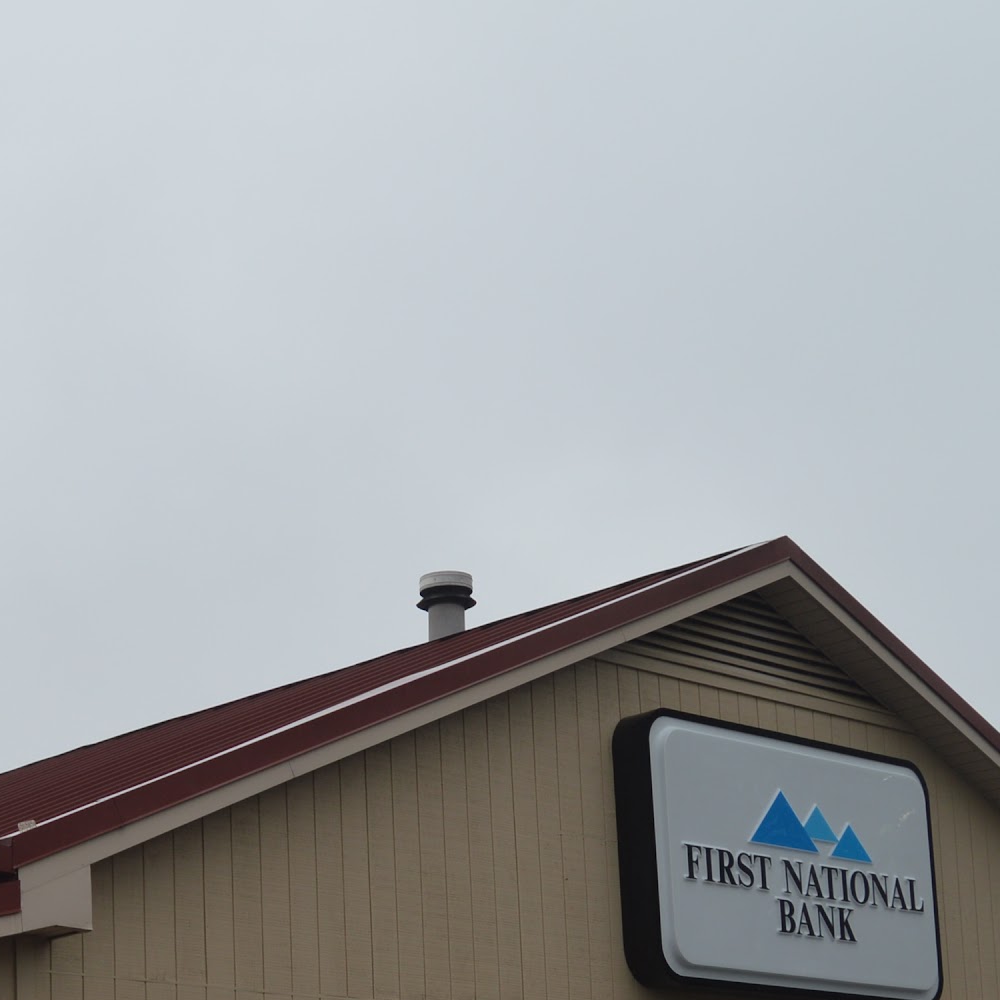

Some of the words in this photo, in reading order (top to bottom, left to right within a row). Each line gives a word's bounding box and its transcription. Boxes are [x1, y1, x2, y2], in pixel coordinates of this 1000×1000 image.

[684, 844, 772, 891] FIRST
[783, 859, 925, 913] NATIONAL
[779, 899, 857, 942] BANK
